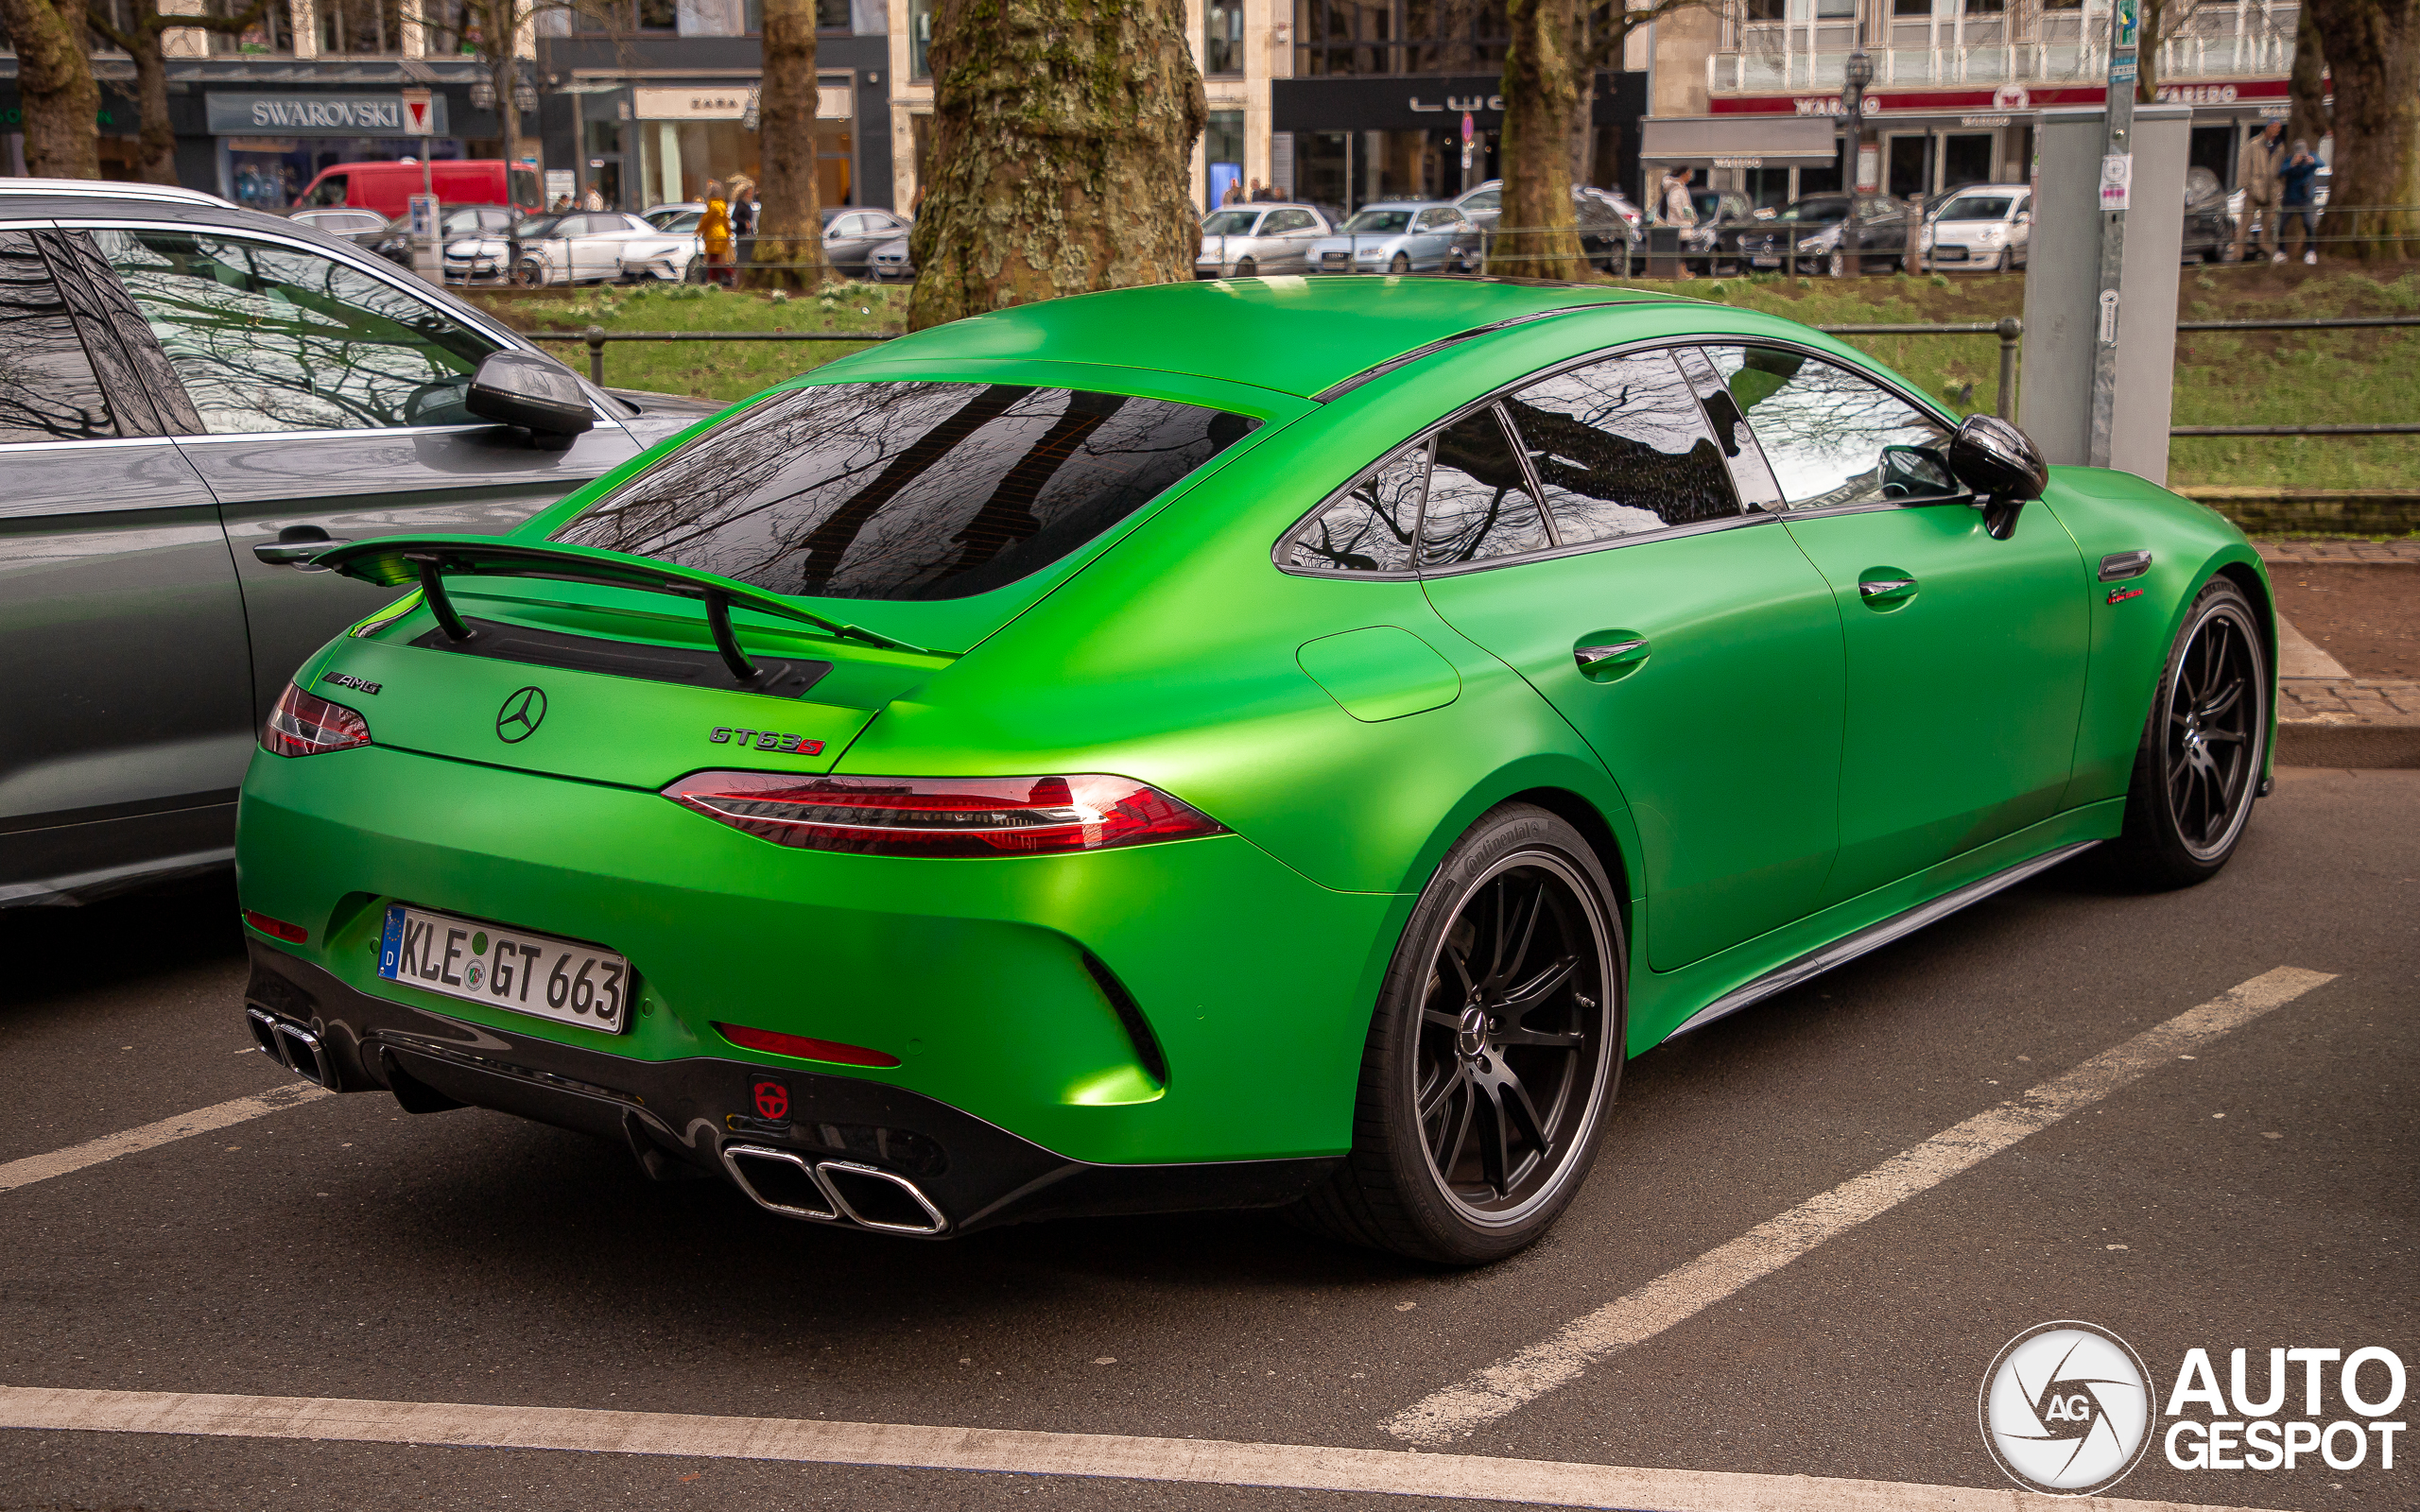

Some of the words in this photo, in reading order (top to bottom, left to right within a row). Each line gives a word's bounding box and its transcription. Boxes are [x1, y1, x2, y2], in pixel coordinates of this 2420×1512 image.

[251, 100, 400, 128] SWAROVSKI
[337, 675, 383, 696] AMG
[1463, 821, 1531, 878] Continental
[385, 950, 395, 967] D
[400, 917, 468, 988] KLE
[490, 938, 543, 1003] GT
[546, 952, 624, 1020] 663
